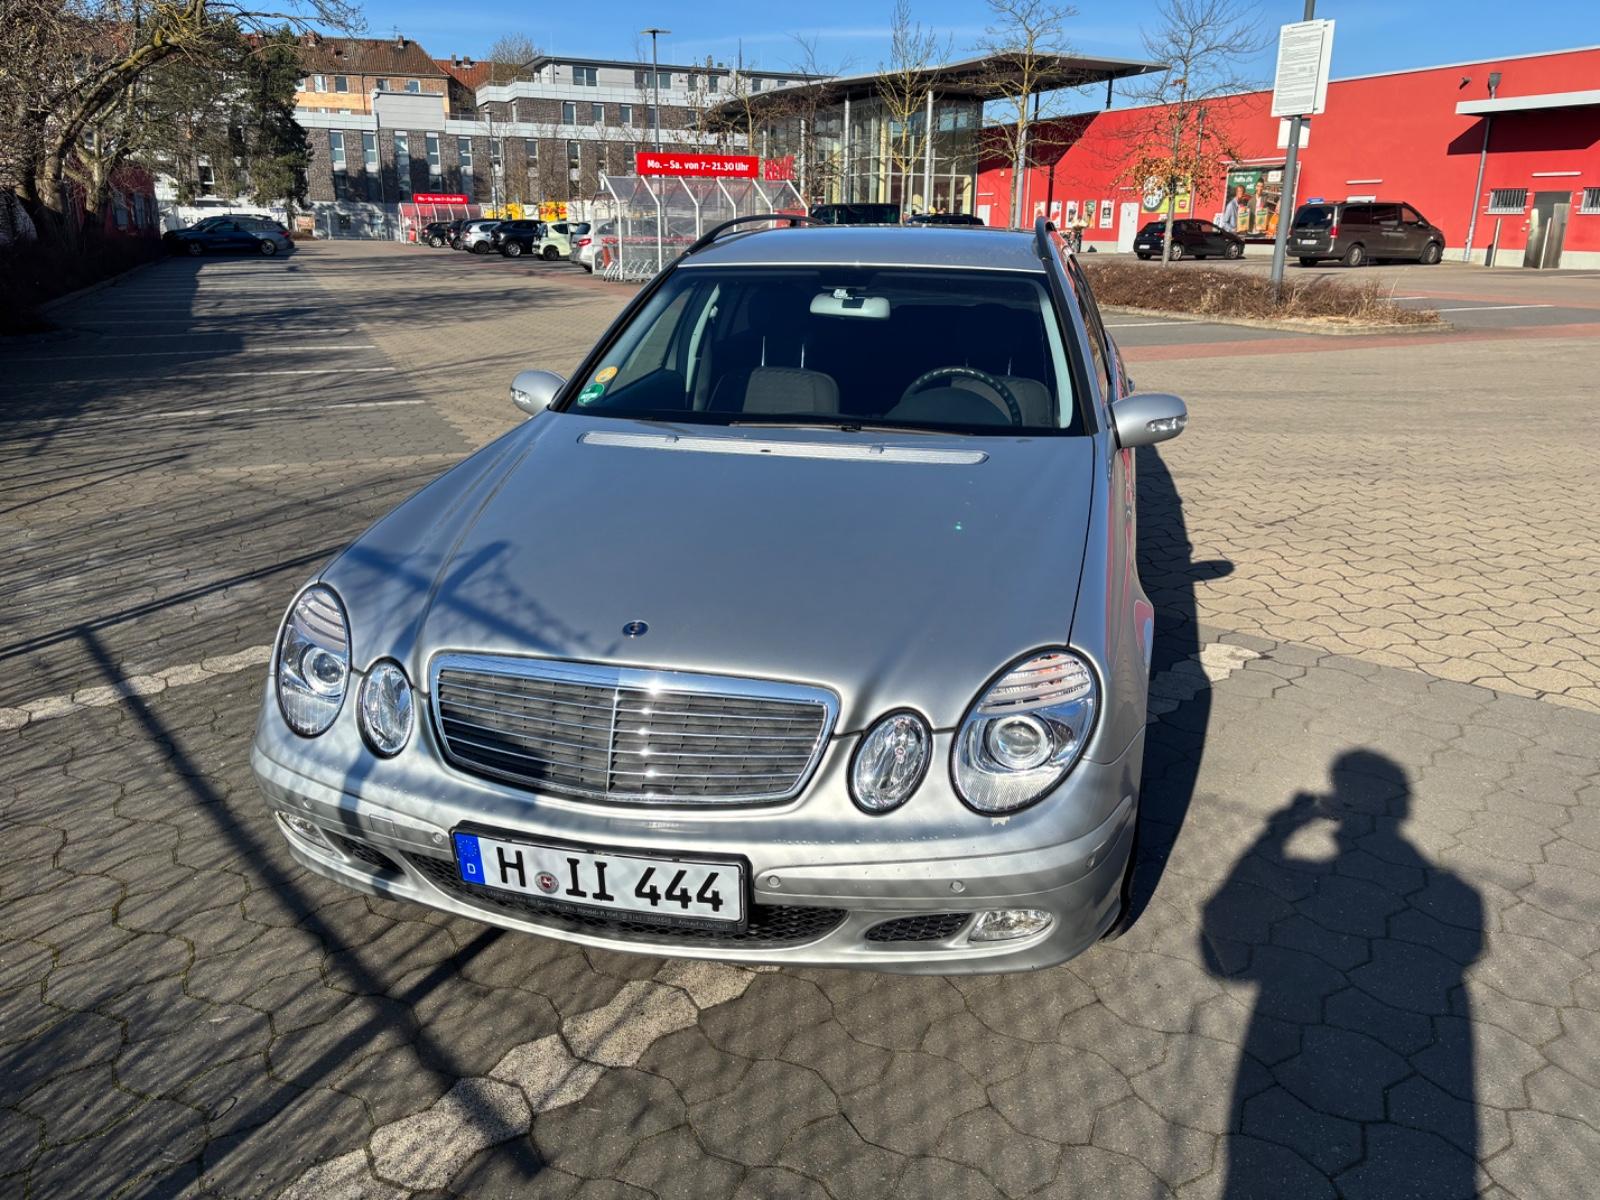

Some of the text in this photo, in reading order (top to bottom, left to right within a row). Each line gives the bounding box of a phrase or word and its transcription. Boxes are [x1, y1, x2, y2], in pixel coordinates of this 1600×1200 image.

[647, 159, 662, 169] Mo.
[669, 160, 682, 169] Sa.
[684, 162, 699, 170] von
[735, 161, 749, 171] Uhr
[467, 863, 476, 875] D
[496, 846, 723, 912] H II 444
